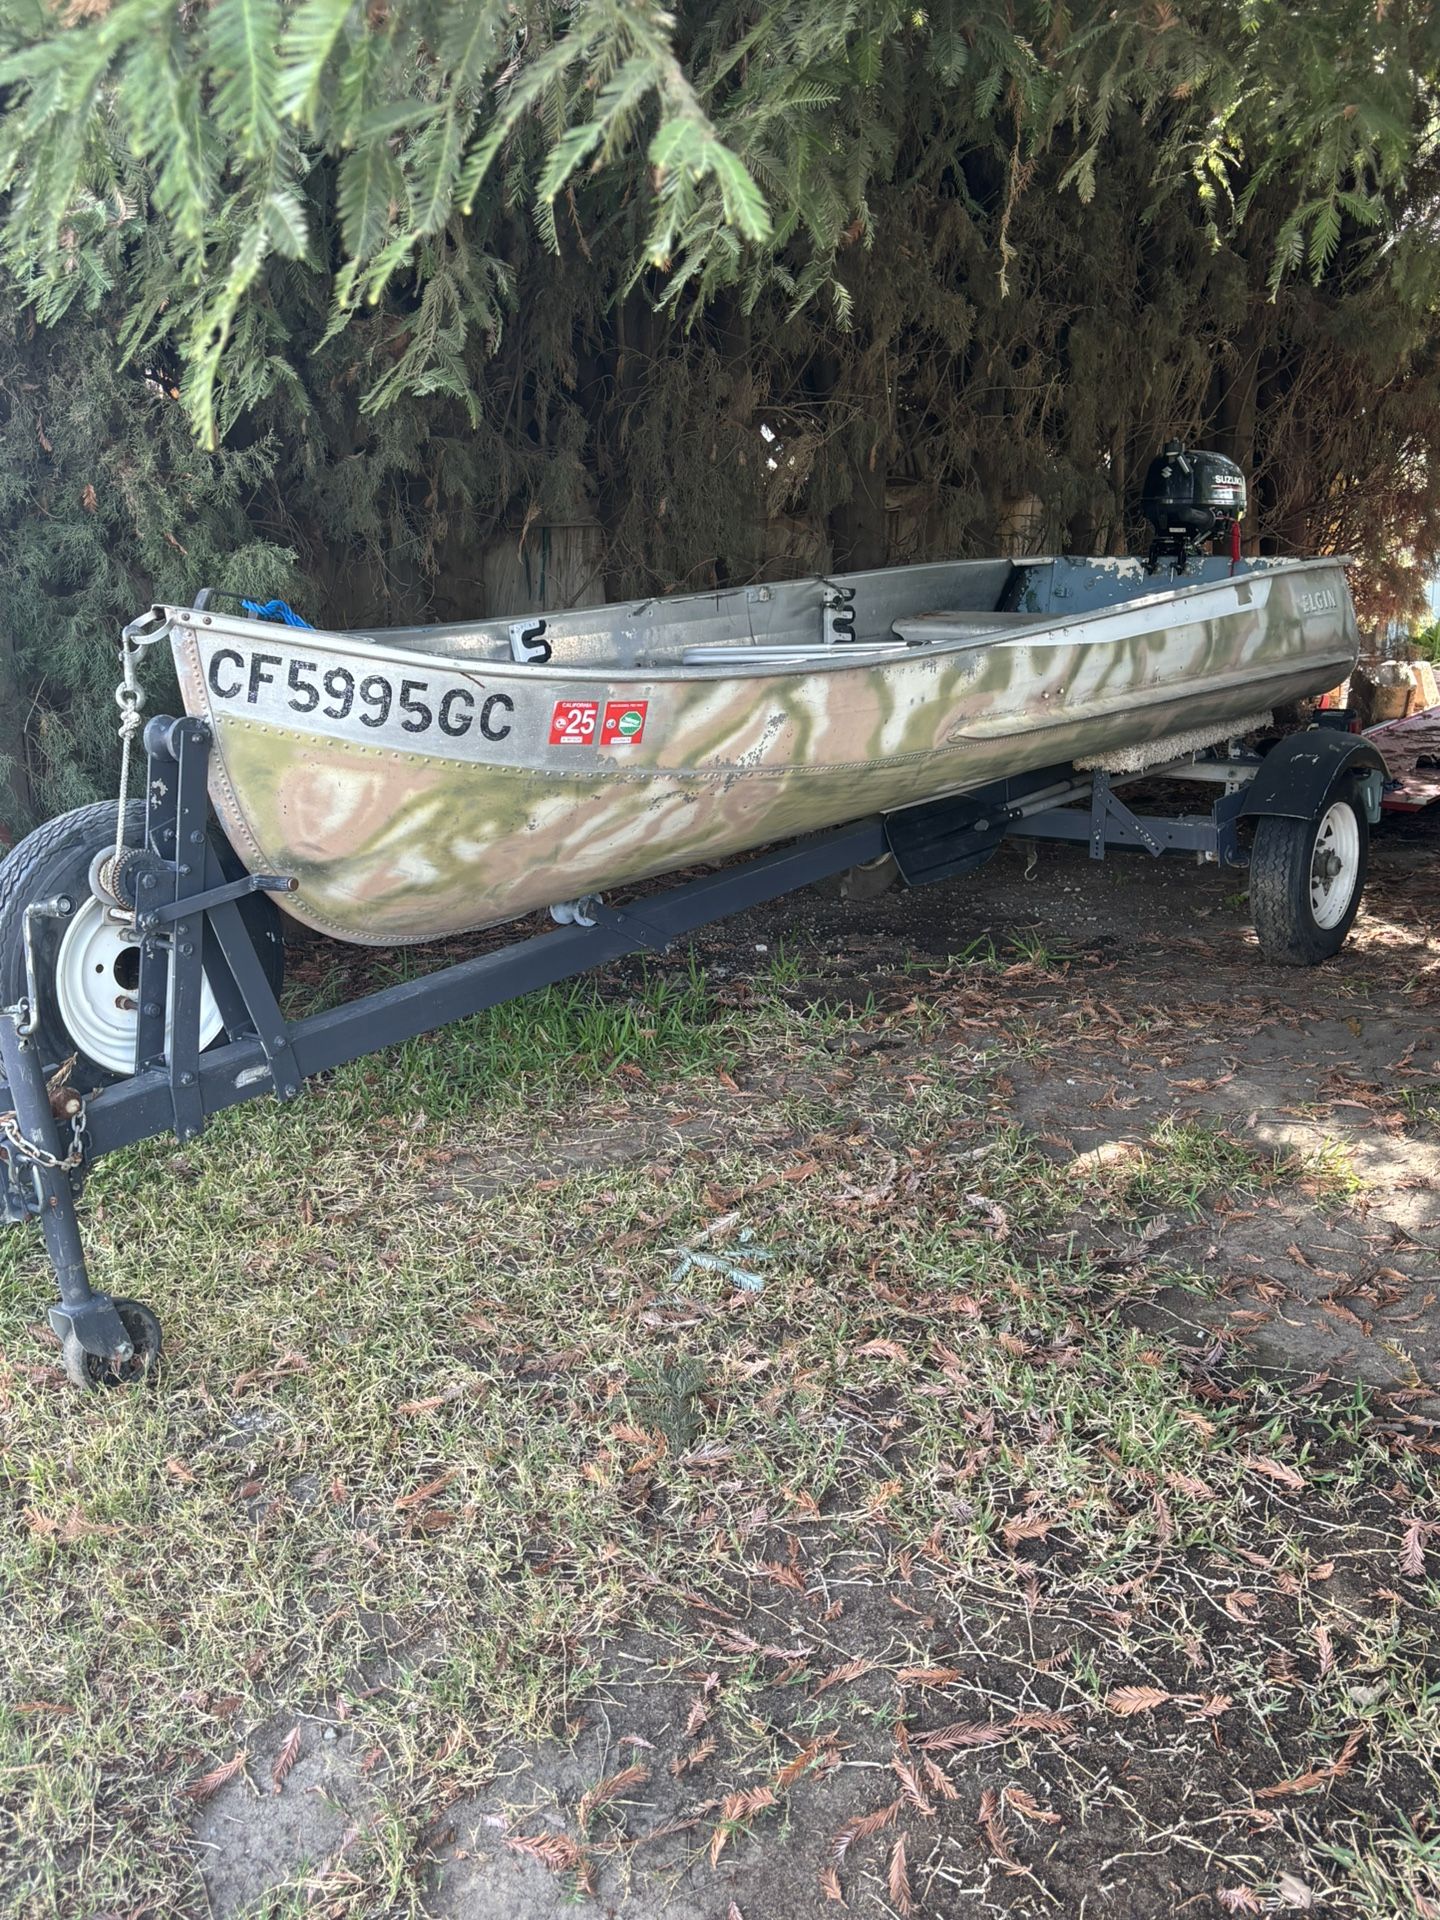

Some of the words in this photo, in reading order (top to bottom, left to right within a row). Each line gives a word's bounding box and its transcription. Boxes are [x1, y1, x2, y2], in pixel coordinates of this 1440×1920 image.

[1215, 475, 1243, 485] SUZUK
[1302, 590, 1337, 613] ELGIN
[208, 648, 515, 741] CF5995GC
[565, 709, 597, 735] 25
